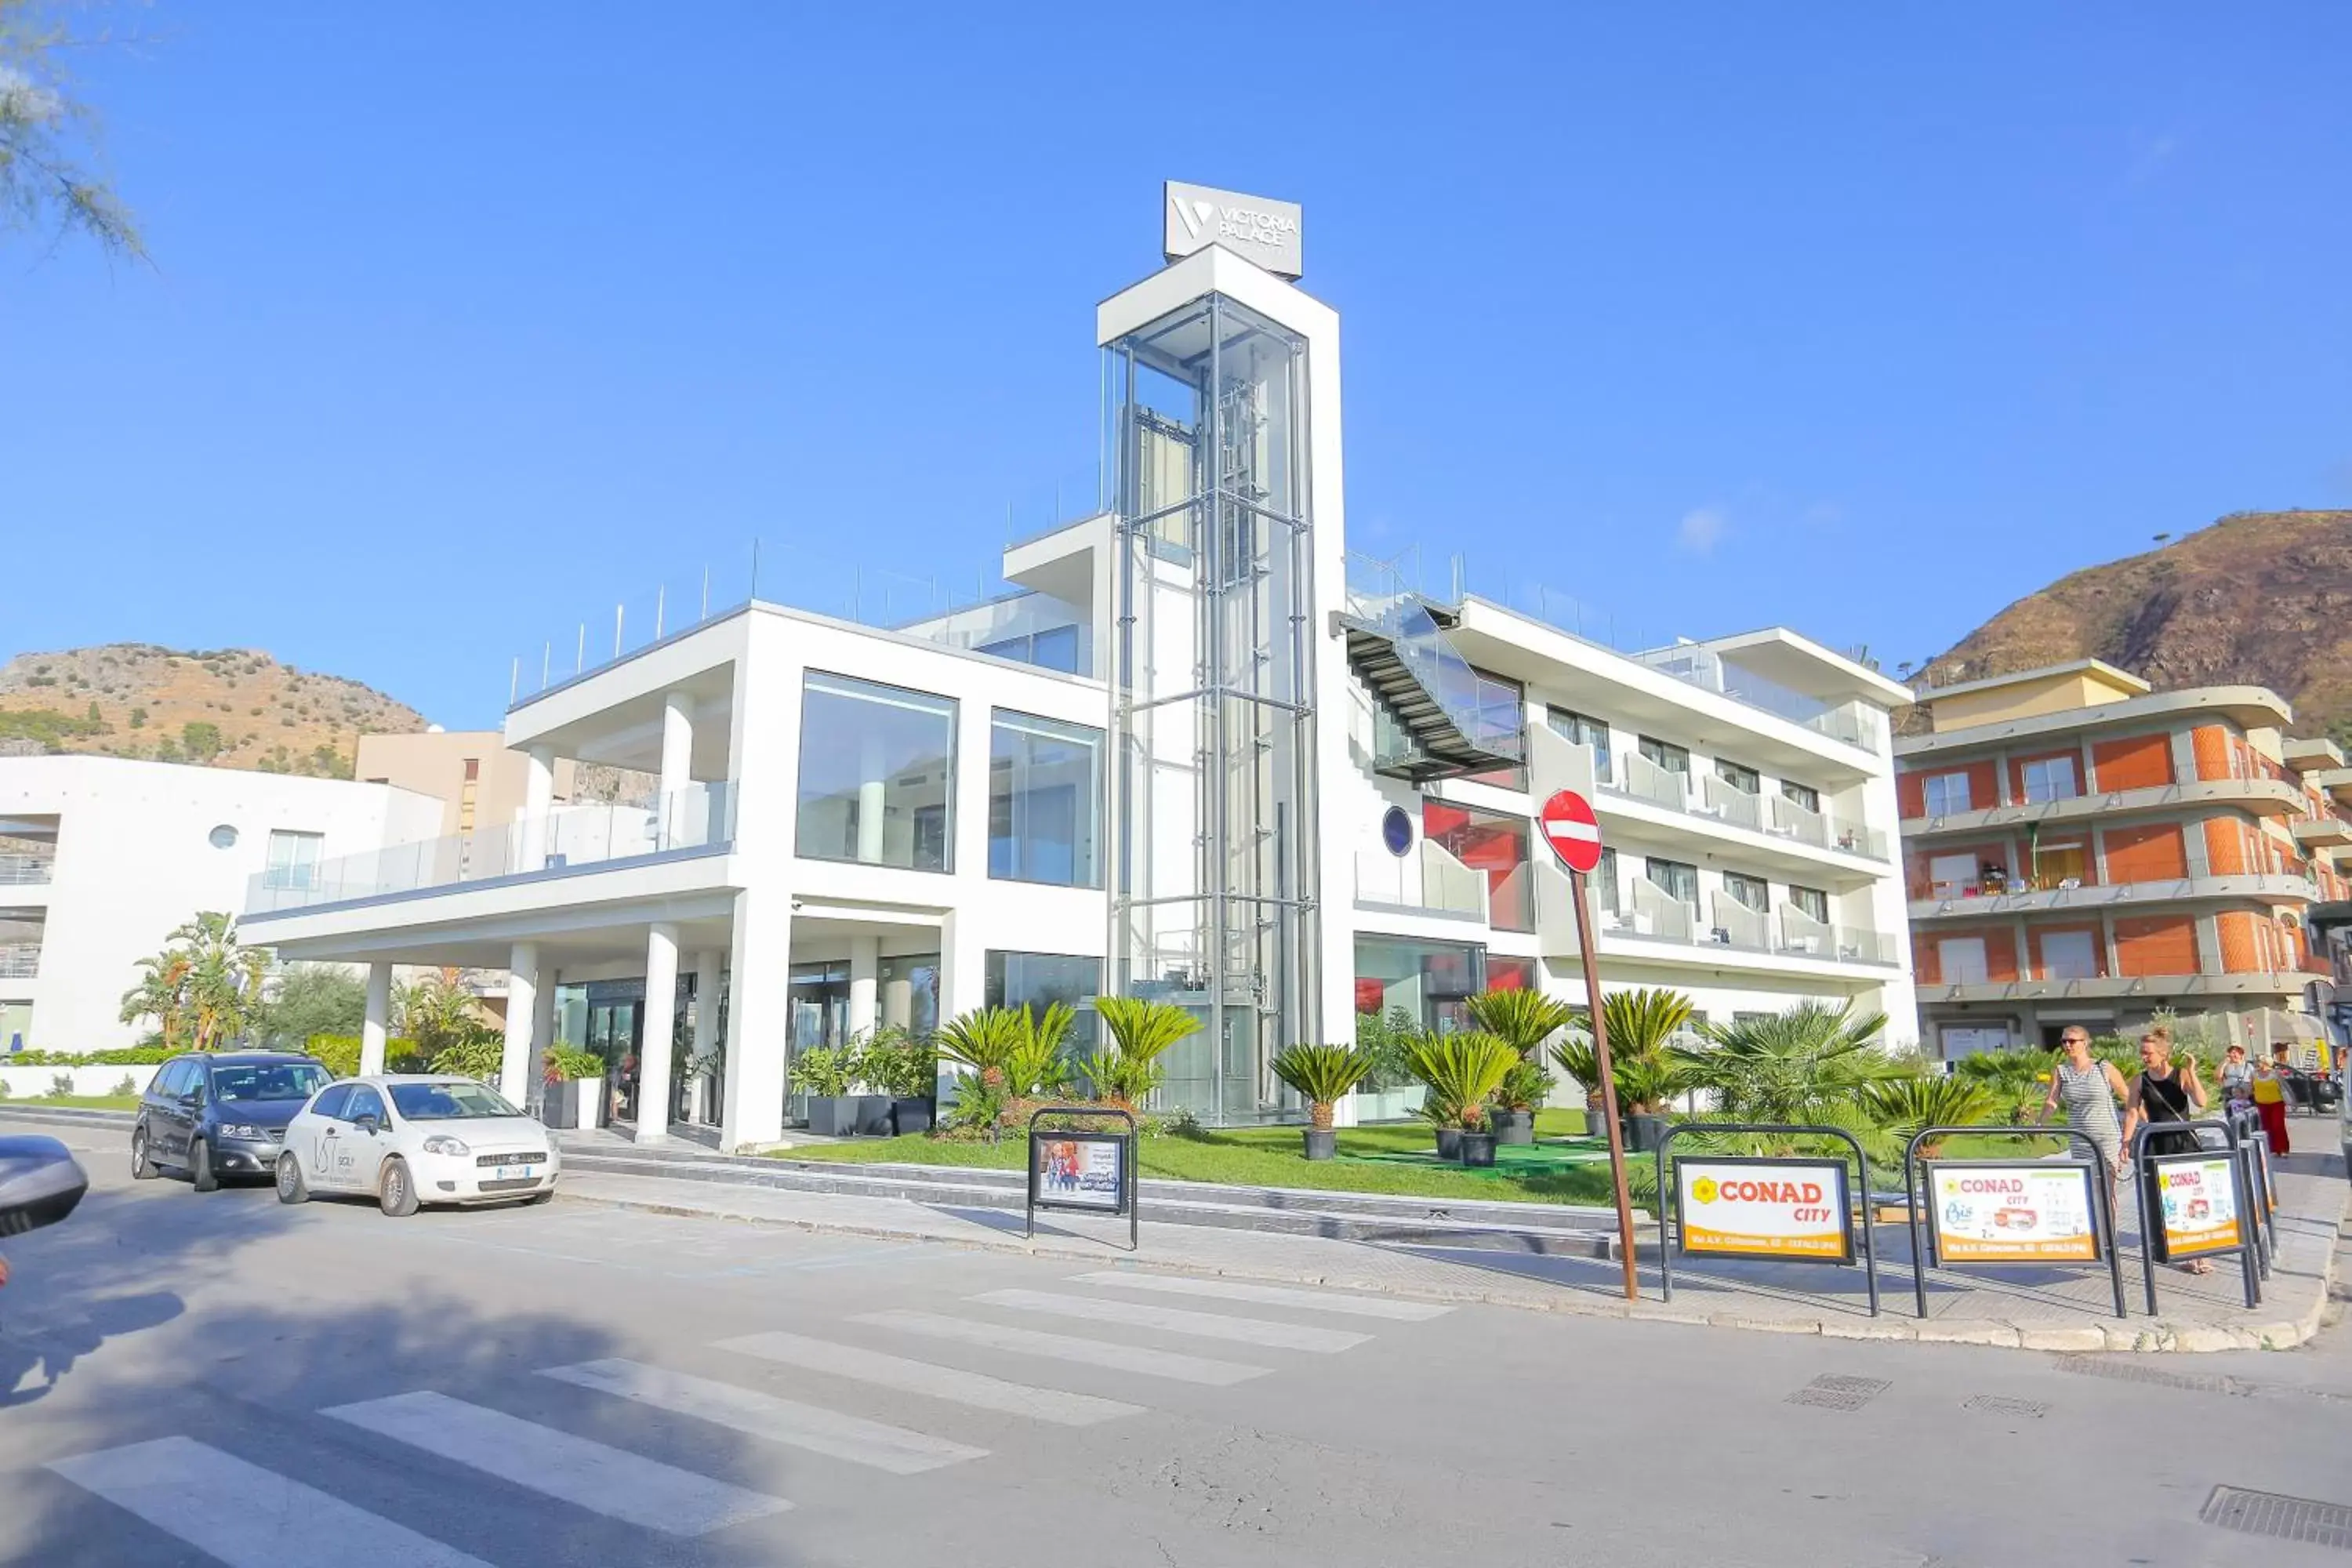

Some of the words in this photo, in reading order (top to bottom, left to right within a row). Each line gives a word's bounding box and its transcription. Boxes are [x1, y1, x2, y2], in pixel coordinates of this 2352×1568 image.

[1218, 205, 1297, 234] VICTORIA
[1220, 221, 1287, 247] PALACE
[1720, 1181, 1823, 1203] CONAD
[1961, 1178, 2024, 1193] CONAD
[2007, 1196, 2029, 1205] CITY
[1794, 1208, 1831, 1221] CITY
